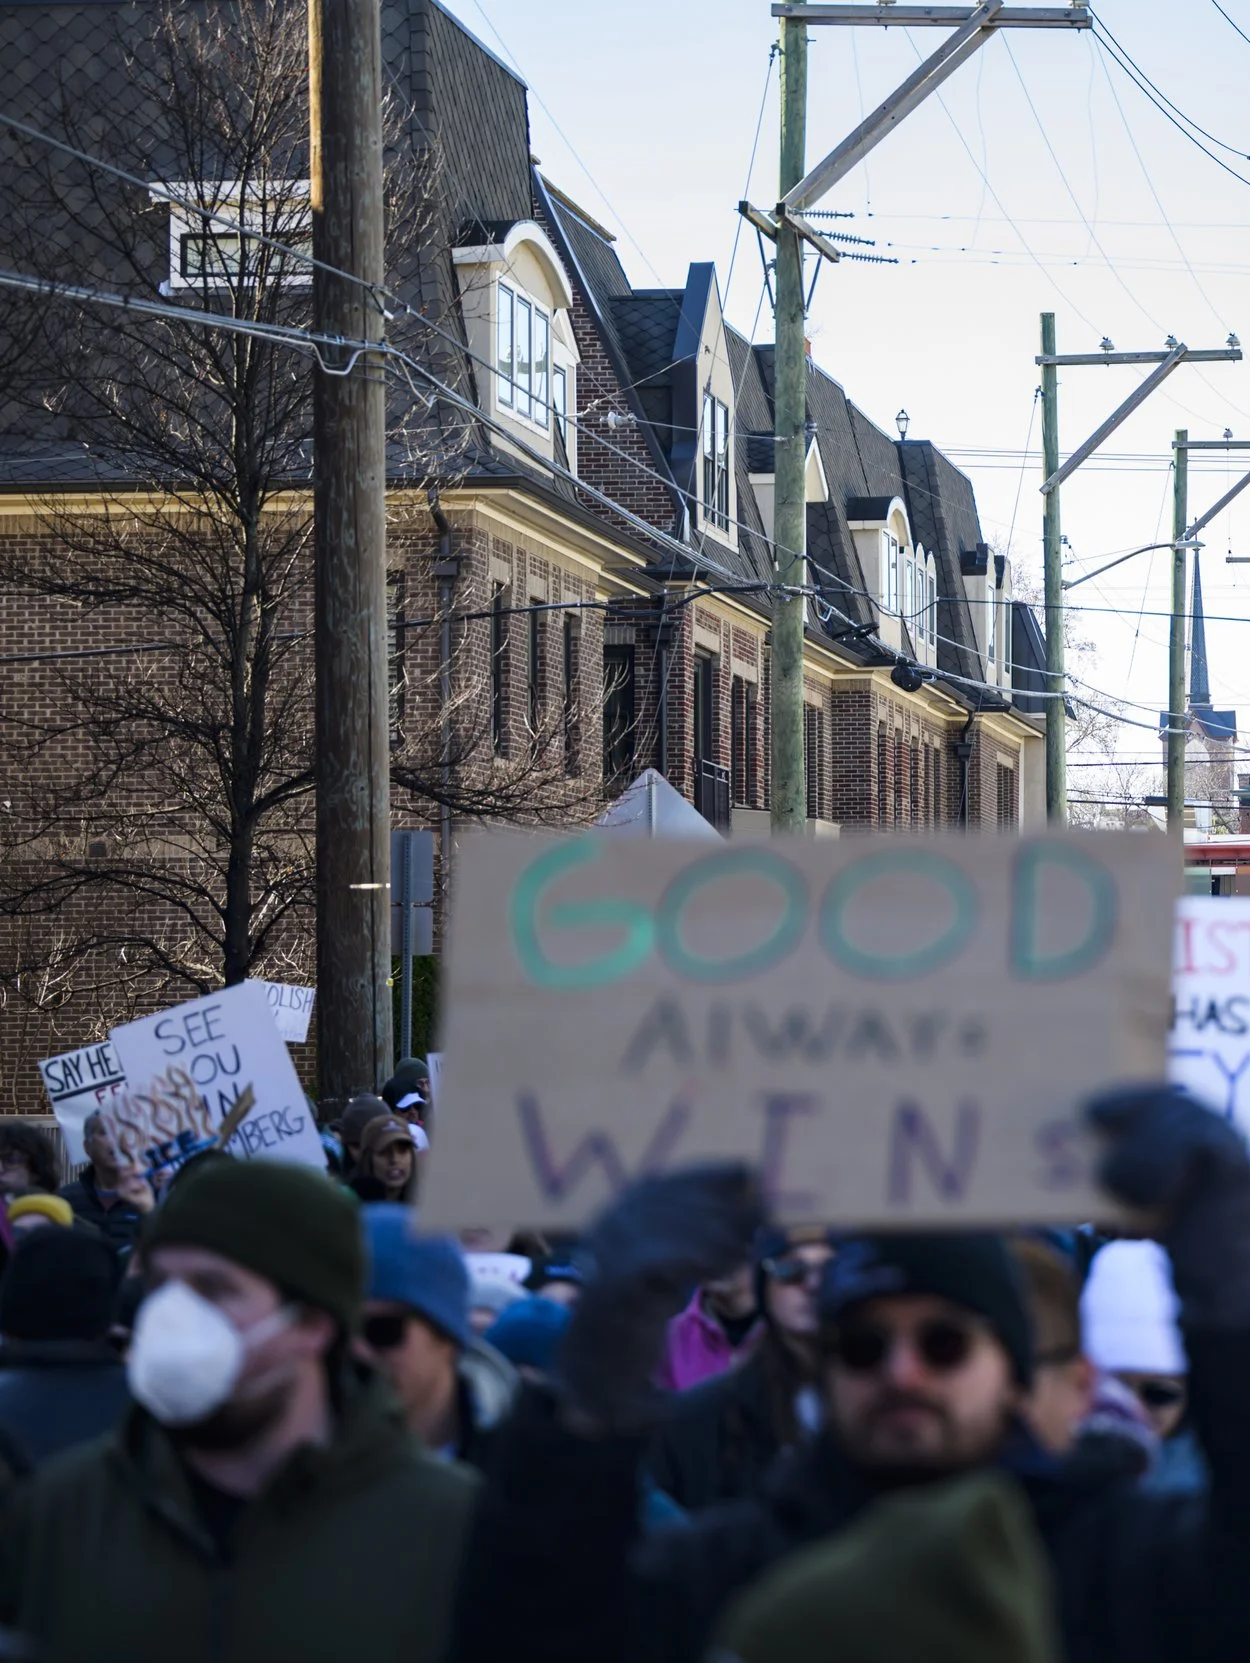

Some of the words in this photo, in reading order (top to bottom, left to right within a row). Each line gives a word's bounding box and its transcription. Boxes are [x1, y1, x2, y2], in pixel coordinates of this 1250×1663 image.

[508, 836, 1121, 991] GOOD
[267, 984, 314, 1014] OLISH
[1169, 995, 1249, 1037] HAS
[154, 1004, 226, 1055] SEE
[44, 1053, 84, 1093] SAY
[85, 1043, 125, 1080] HE
